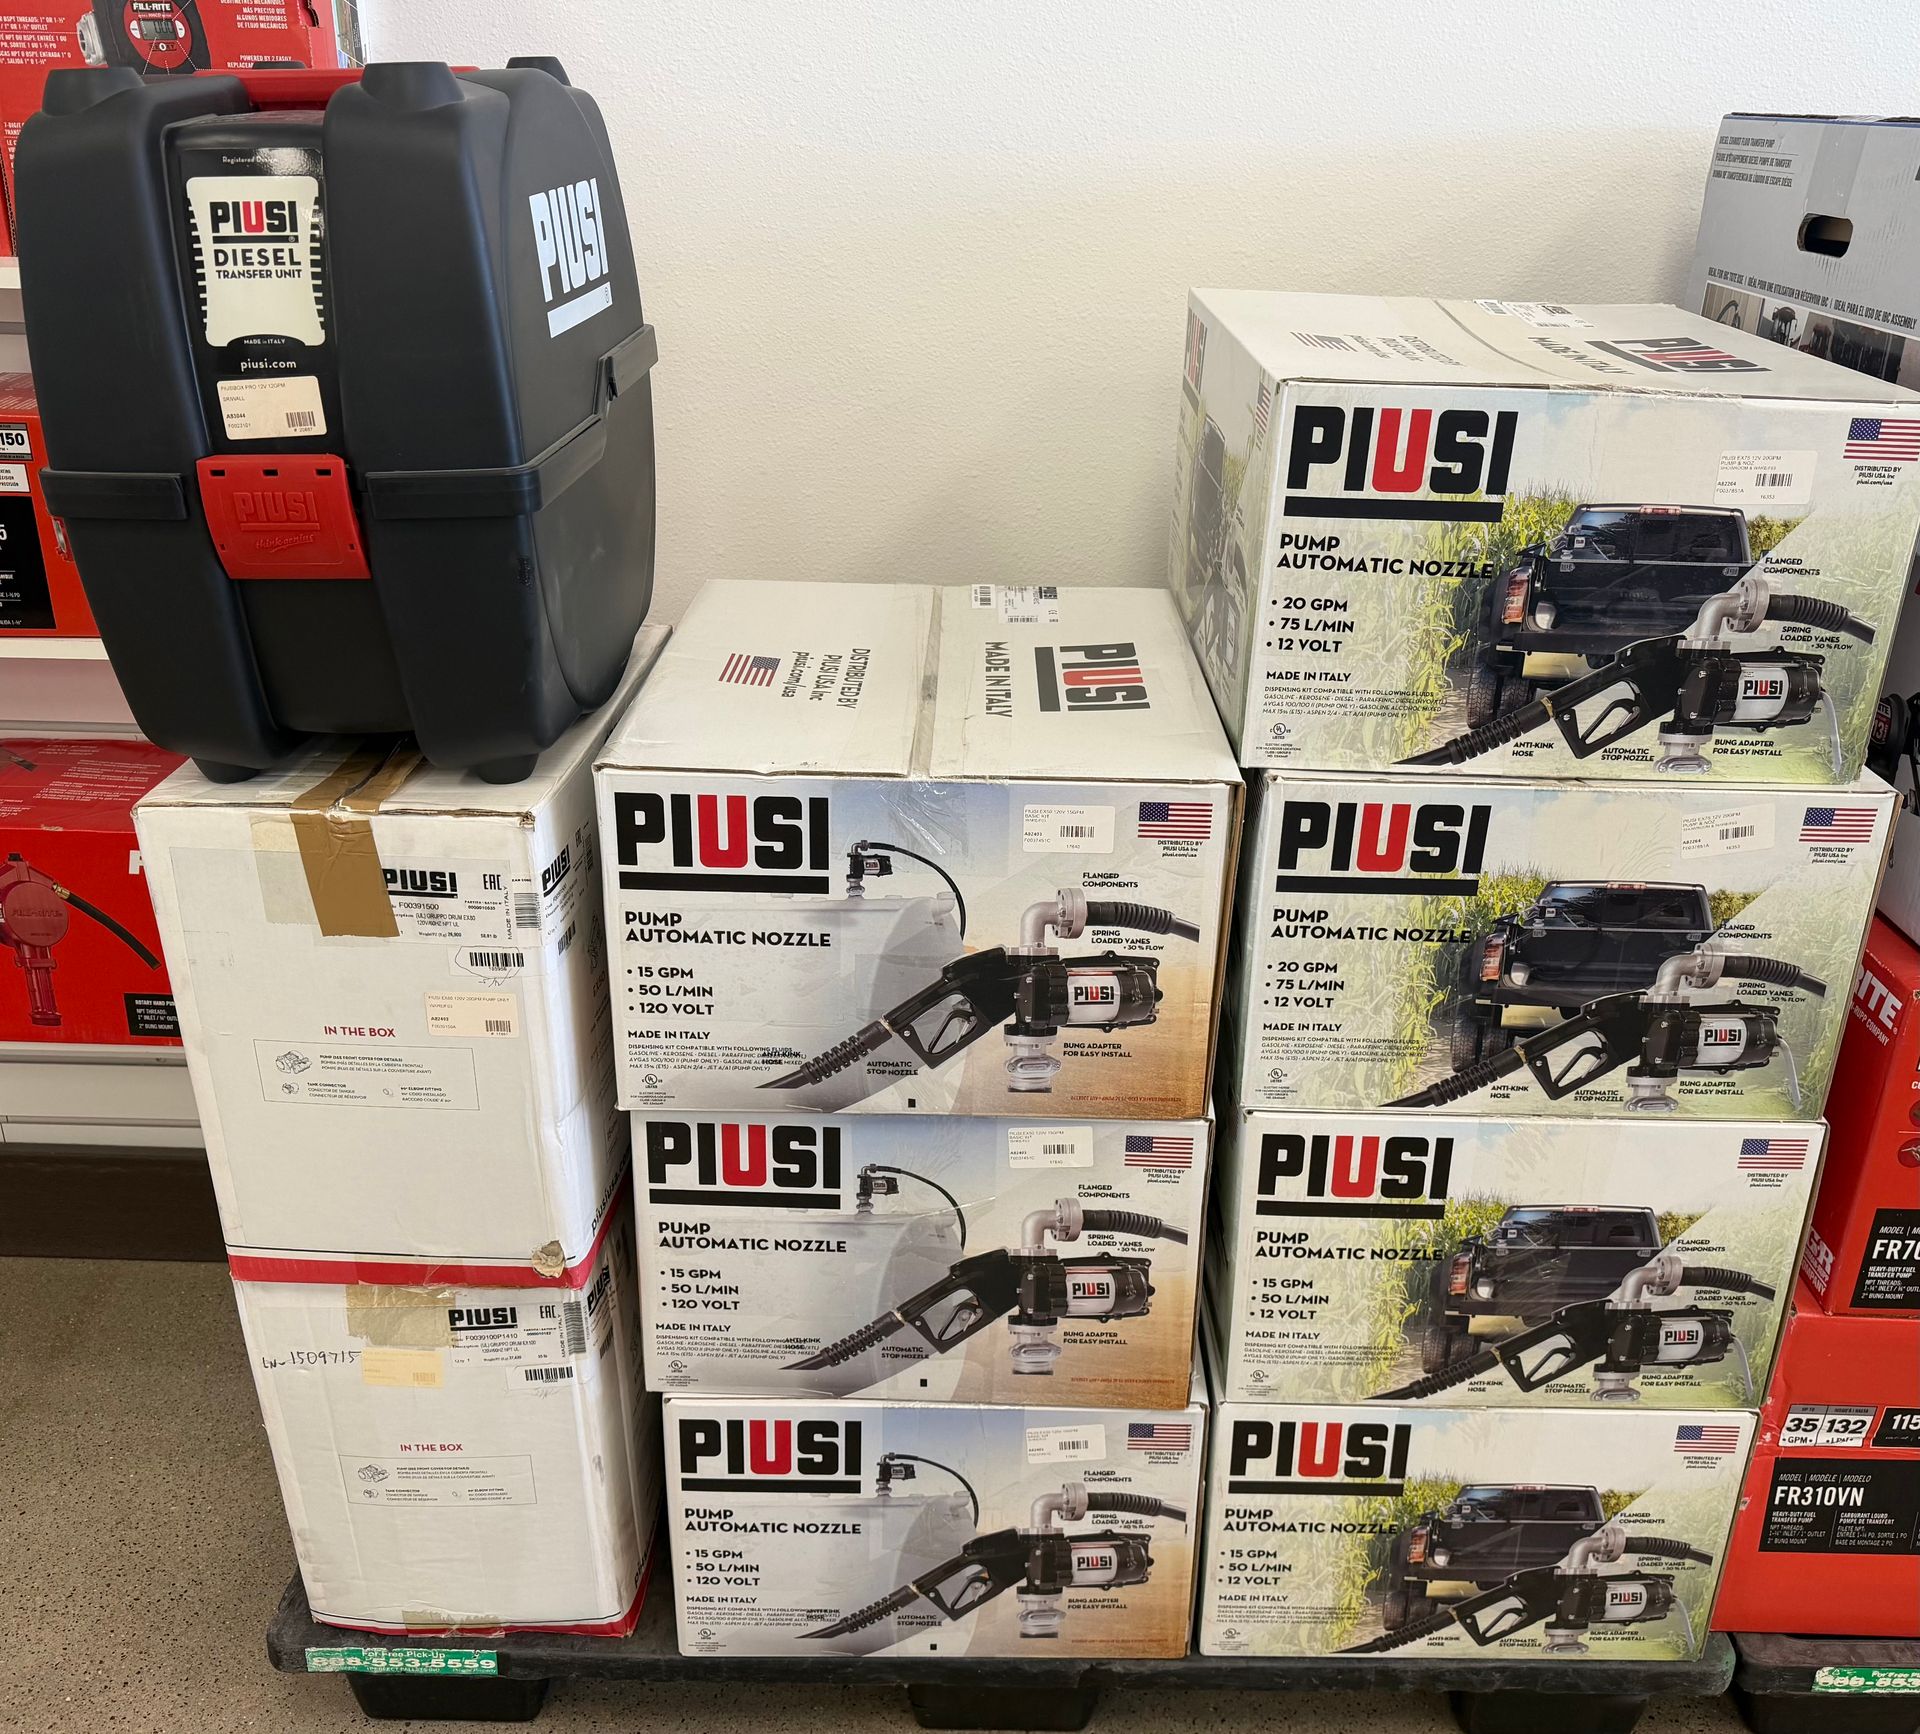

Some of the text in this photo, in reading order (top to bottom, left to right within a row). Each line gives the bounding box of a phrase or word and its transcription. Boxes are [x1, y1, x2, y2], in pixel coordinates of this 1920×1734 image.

[133, 3, 171, 11] FILL-RITE
[210, 201, 298, 233] PIUSI
[528, 178, 609, 303] PIUSI
[214, 248, 302, 266] DIESEL
[216, 269, 302, 280] TRANSFER UNIT
[1846, 302, 1858, 315] PARA
[1858, 305, 1864, 317] EL
[1874, 309, 1882, 320] DE
[1891, 313, 1917, 330] ASSEMBLY
[241, 358, 296, 373] piusi.com
[1287, 405, 1518, 495] PIUSI
[1854, 465, 1890, 473] DISTRIBUTED
[233, 491, 318, 522] PIUSI
[1280, 534, 1340, 552] PUMP
[1277, 553, 1494, 578] AUTOMATIC NOZZLE
[1765, 557, 1803, 565] FLANGED
[1764, 566, 1820, 576] COMPONENTS
[1283, 597, 1348, 612] 20 GPM
[1281, 618, 1354, 633] 75 L/MIN
[1782, 626, 1811, 635] SPRING
[1278, 638, 1342, 652] 12 VOLT
[1780, 635, 1840, 644] LOADED VANES
[985, 642, 1013, 718] MADE IN ITALY
[1059, 642, 1151, 711] PIUSI
[1266, 671, 1351, 682] MADE IN ITALY
[1743, 679, 1783, 695] PIUSI
[1715, 739, 1774, 748] BUNG ADAPTER
[1713, 747, 1783, 757] FOR EASY INSTALL
[614, 792, 829, 870] PIUSI
[1278, 801, 1492, 873] PIUSI
[382, 868, 458, 892] PIUSI
[625, 911, 682, 926] PUMP
[1273, 908, 1328, 923] PUMP
[625, 929, 831, 946] AUTOMATIC NOZZLE
[1271, 925, 1471, 943] AUTOMATIC NOZZLE
[638, 966, 694, 979] 15 GPM
[1278, 961, 1338, 973] 20 GPM
[639, 985, 713, 997] 50 L/MIN
[1276, 979, 1344, 991] 75 L/MIN
[1074, 985, 1115, 1001] PIUSI
[1274, 996, 1334, 1008] 12 VOLT
[639, 1003, 714, 1015] 120 VOLT
[324, 1026, 396, 1038] IN THE BOX
[1704, 1029, 1742, 1043] PIUSI
[646, 1121, 841, 1189] PIUSI
[1258, 1134, 1454, 1199] PIUSI
[659, 1222, 711, 1235] PUMP
[1879, 1226, 1904, 1234] MODEL
[659, 1237, 847, 1252] AUTOMATIC NOZZLE
[1256, 1232, 1308, 1244] PUMP
[1255, 1246, 1444, 1261] AUTOMATIC NOZZLE
[670, 1268, 721, 1279] 15 GPM
[671, 1284, 739, 1295] 50 L/MIN
[1072, 1282, 1110, 1295] PIUSI
[1262, 1278, 1313, 1289] 15 GPM
[672, 1299, 740, 1310] 120 VOLT
[1261, 1294, 1329, 1305] 50 L/MIN
[448, 1307, 517, 1326] PIUSI
[1260, 1309, 1317, 1320] 12 VOLT
[1785, 1417, 1867, 1434] 35 132
[1788, 1436, 1808, 1444] GPM
[439, 1443, 463, 1451] BOX
[679, 1419, 862, 1475] PIUSI
[1230, 1420, 1412, 1479] PIUSI
[1779, 1473, 1872, 1483] MODEL MODÈLE MODELO
[1774, 1486, 1864, 1506] FR310VN
[685, 1508, 733, 1519] PUMP
[1224, 1509, 1273, 1520] PUMP
[685, 1521, 861, 1534] AUTOMATIC NOZZLE
[1223, 1521, 1398, 1534] AUTOMATIC NOZZLE
[695, 1550, 743, 1559] 15 GPM
[1230, 1549, 1277, 1559] 15 GPM
[696, 1563, 760, 1573] 50 L/MIN
[1229, 1563, 1292, 1573] 50 L/MIN
[696, 1576, 760, 1586] 120 VOLT
[1227, 1576, 1280, 1585] 12 VOLT
[406, 1651, 445, 1659] Pick-Up
